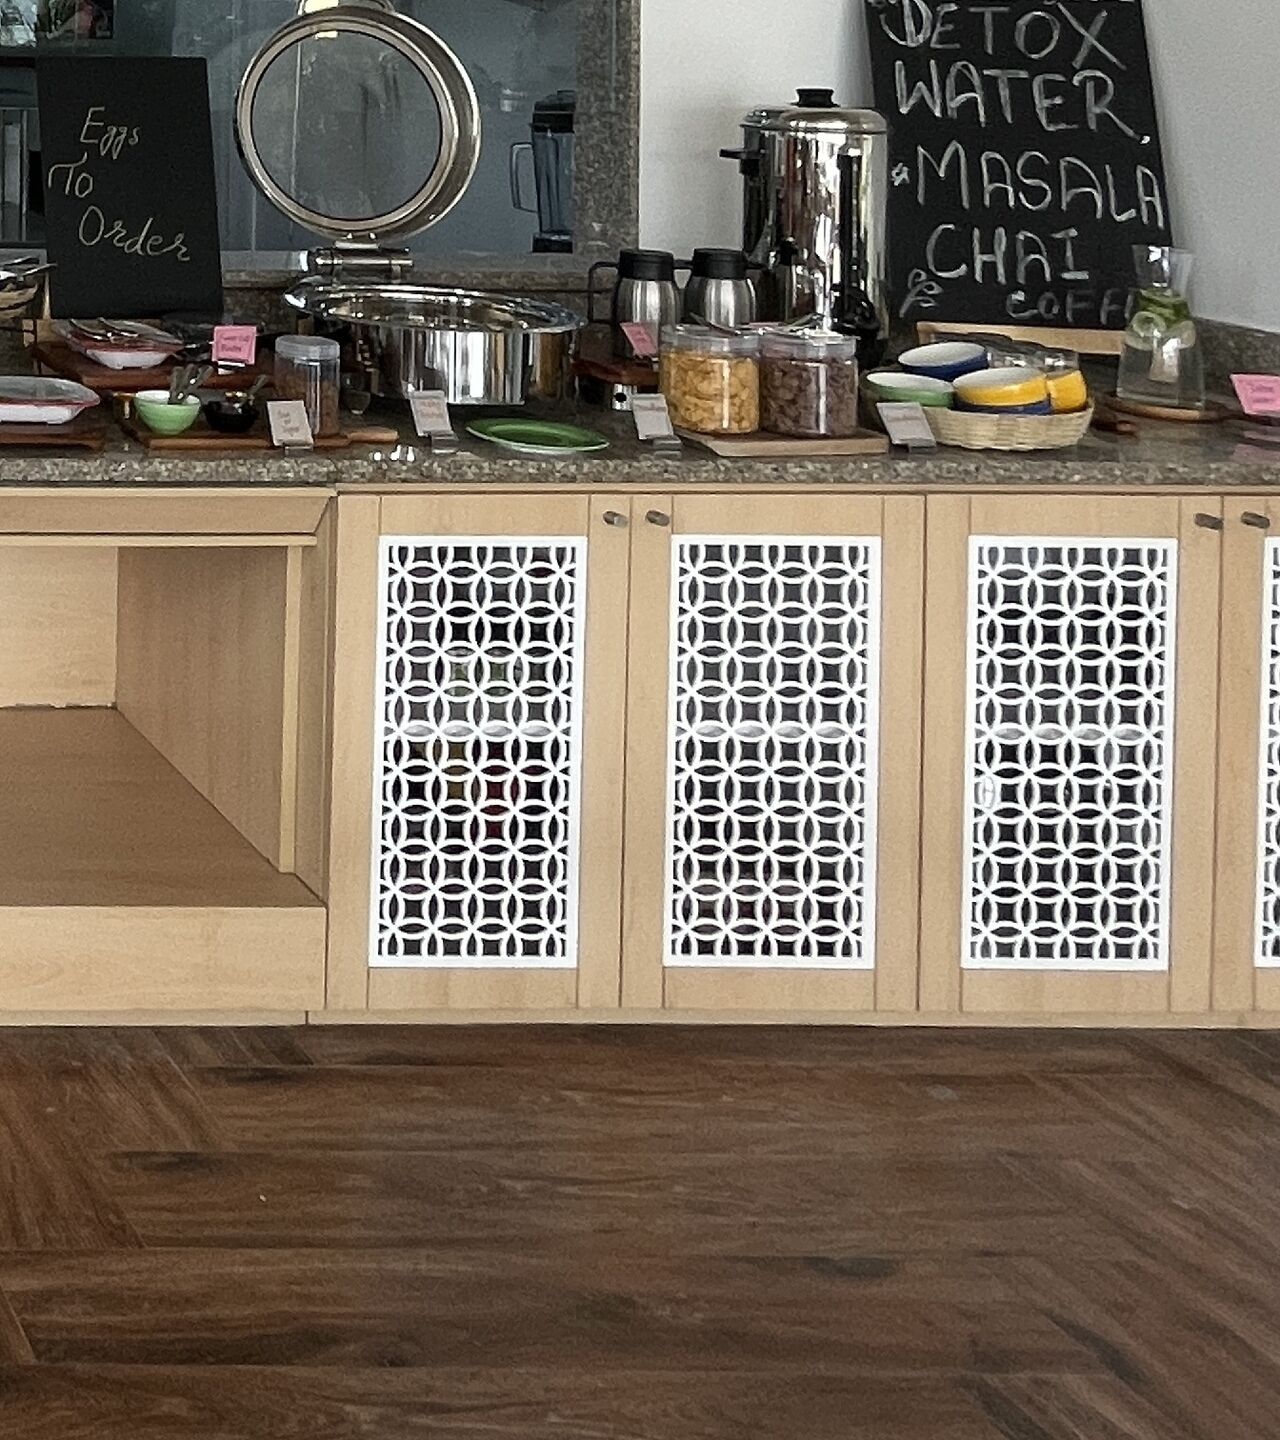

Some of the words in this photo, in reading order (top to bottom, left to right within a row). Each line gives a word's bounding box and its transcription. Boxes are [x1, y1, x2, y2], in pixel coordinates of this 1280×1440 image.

[895, 60, 1150, 144] WATER
[80, 107, 141, 160] Eggs
[48, 152, 93, 198] To
[917, 140, 1165, 230] MASALA
[78, 205, 190, 261] Order
[926, 224, 1089, 284] CHAI
